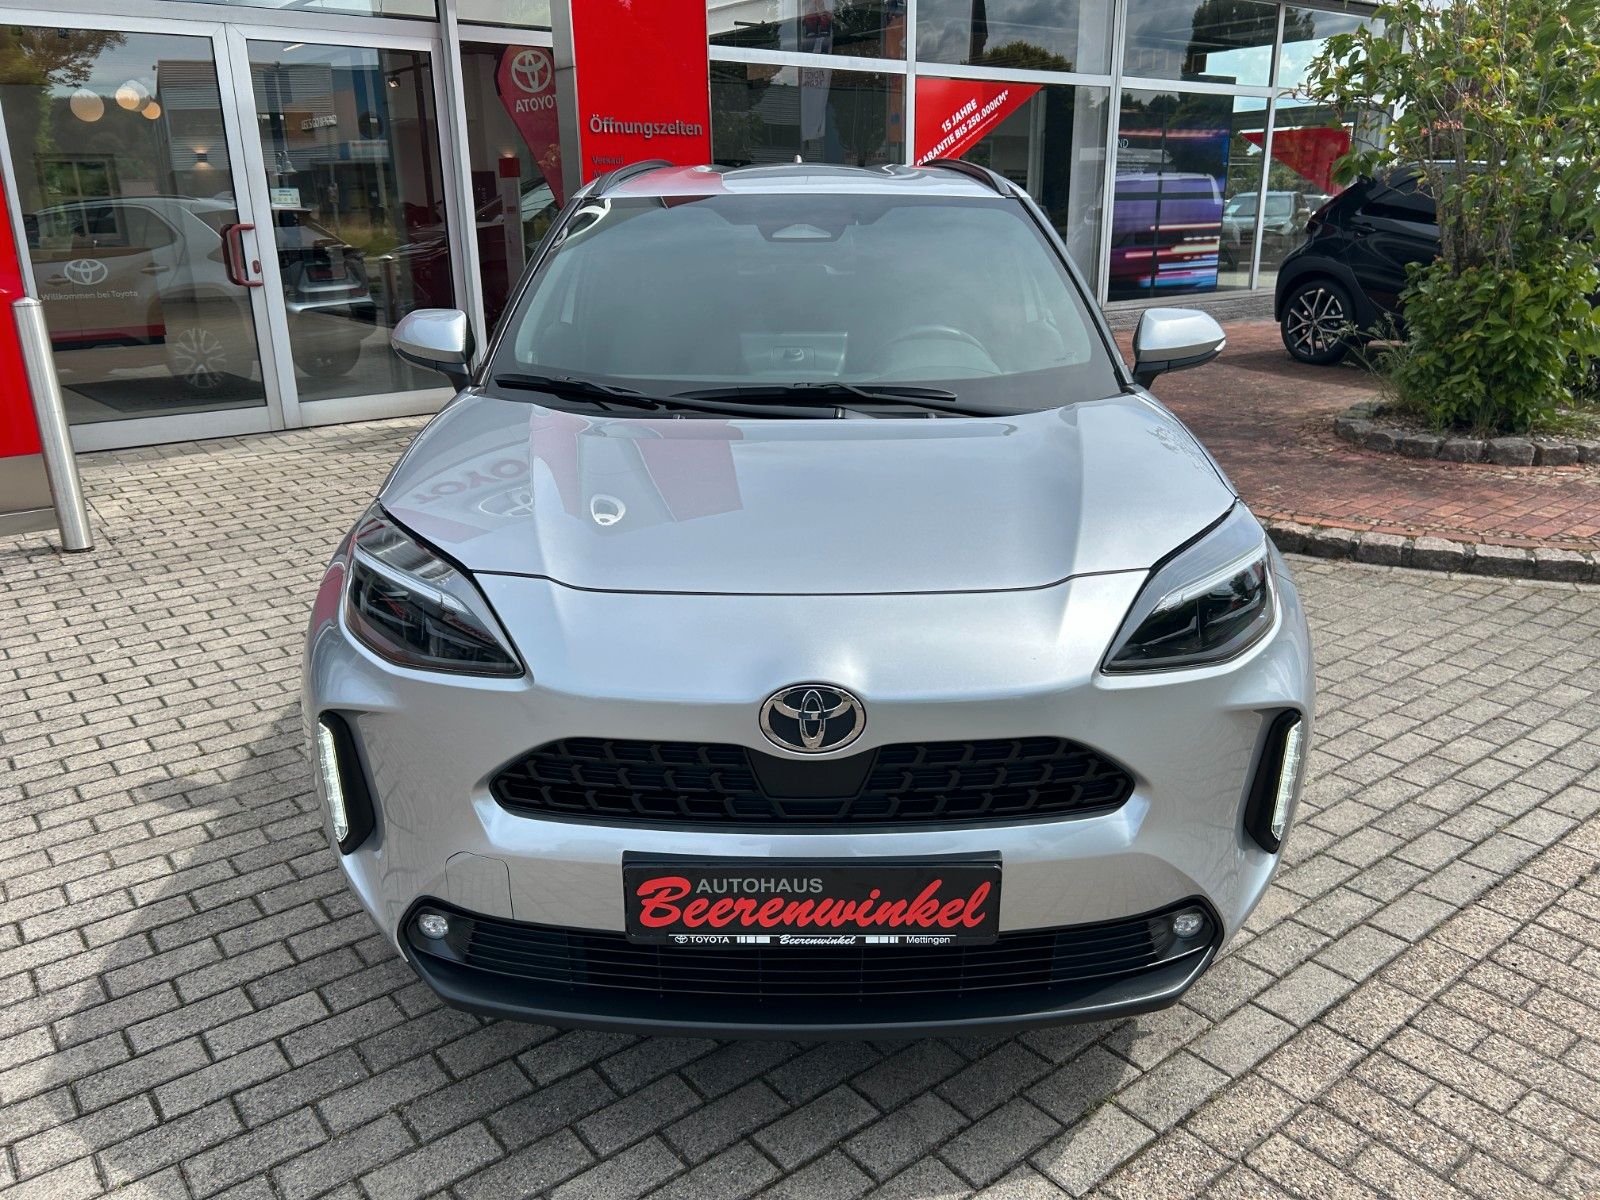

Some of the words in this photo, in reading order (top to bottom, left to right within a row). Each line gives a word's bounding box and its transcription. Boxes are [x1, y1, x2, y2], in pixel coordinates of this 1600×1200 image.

[941, 119, 952, 132] 15
[951, 98, 978, 125] JAHRE
[590, 114, 702, 138] Öffnungszeiten
[954, 125, 968, 138] BIS
[41, 292, 96, 301] Willkommen
[97, 290, 111, 299] bei
[112, 291, 138, 299] Toyota
[695, 877, 824, 894] AUTOHAUS
[635, 875, 992, 929] Beerenwinkel
[689, 936, 730, 944] TOYOTA
[779, 934, 856, 945] Beerenwinkel
[906, 935, 951, 946] Mettingen
